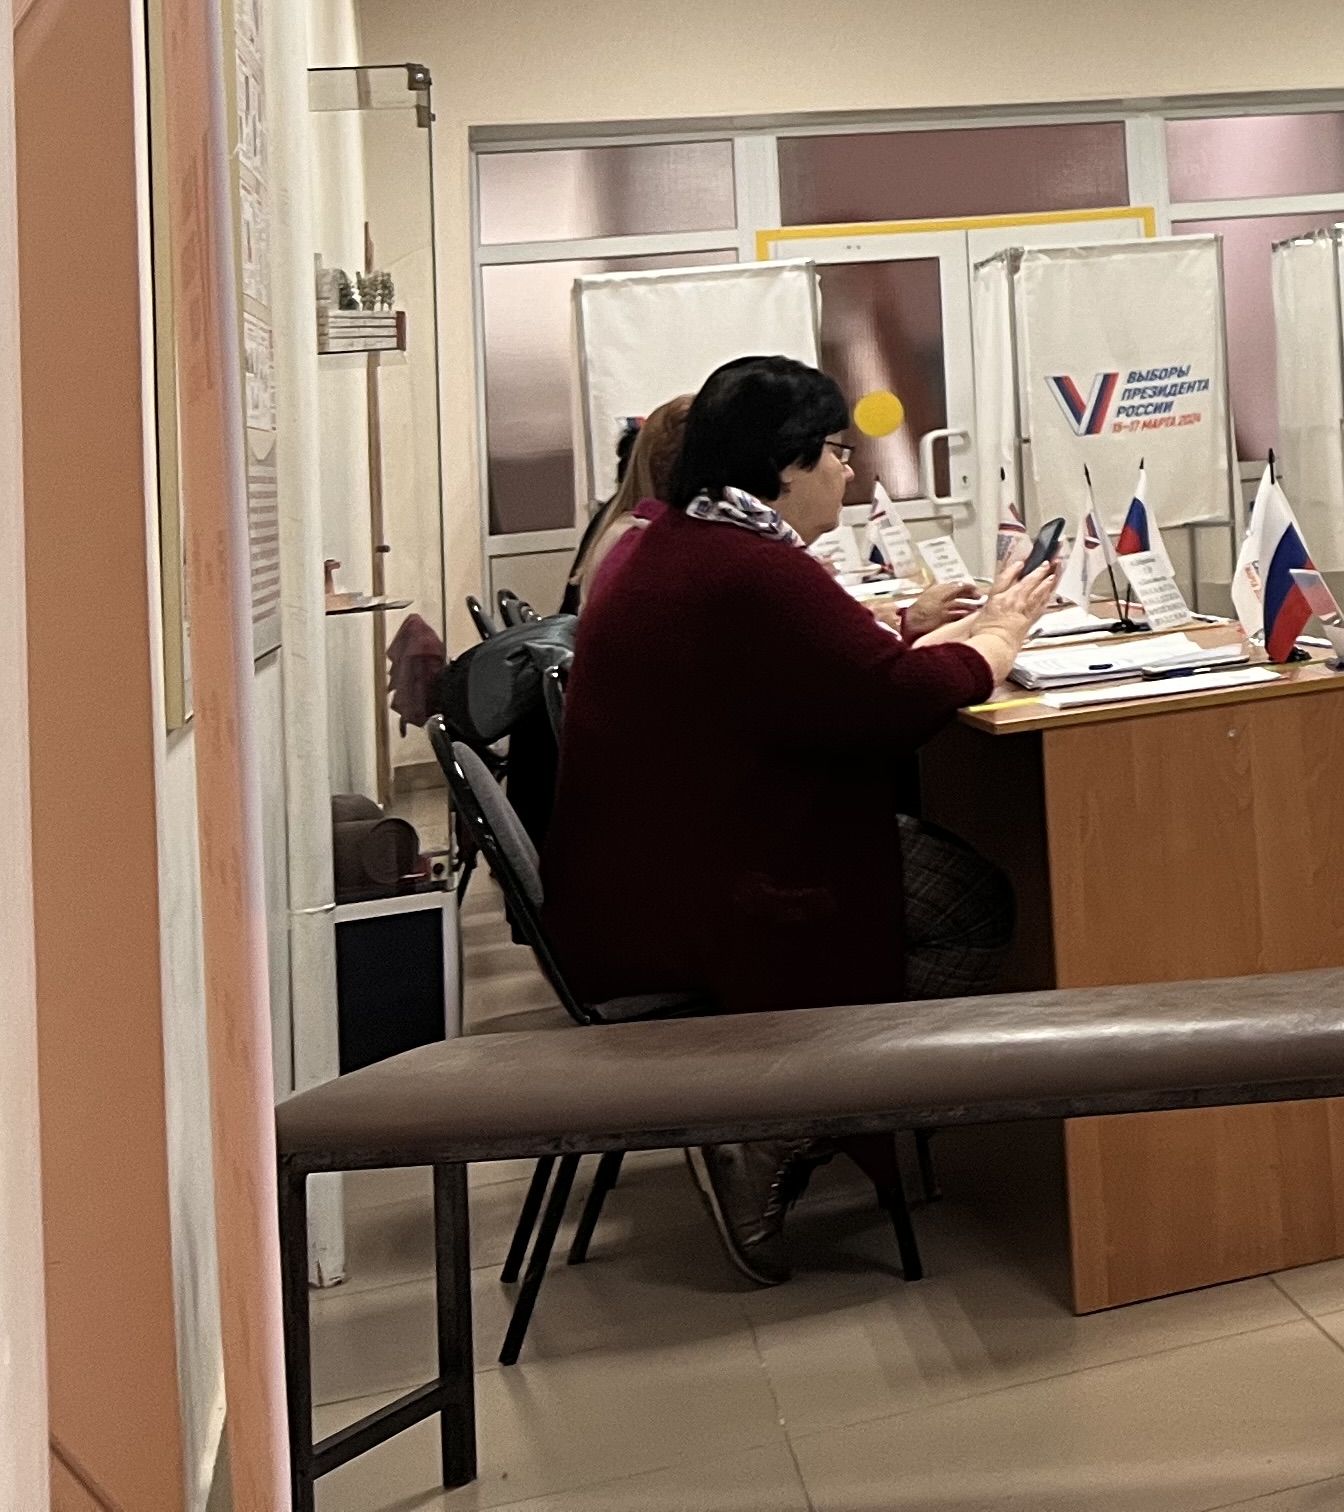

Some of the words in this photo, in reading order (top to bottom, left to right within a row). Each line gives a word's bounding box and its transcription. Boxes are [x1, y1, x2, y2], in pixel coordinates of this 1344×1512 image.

[1126, 365, 1191, 384] ВЫБОРЫ
[1121, 379, 1209, 401] ПРЕЗИДЕНТА
[1116, 401, 1174, 418] РОССИИ
